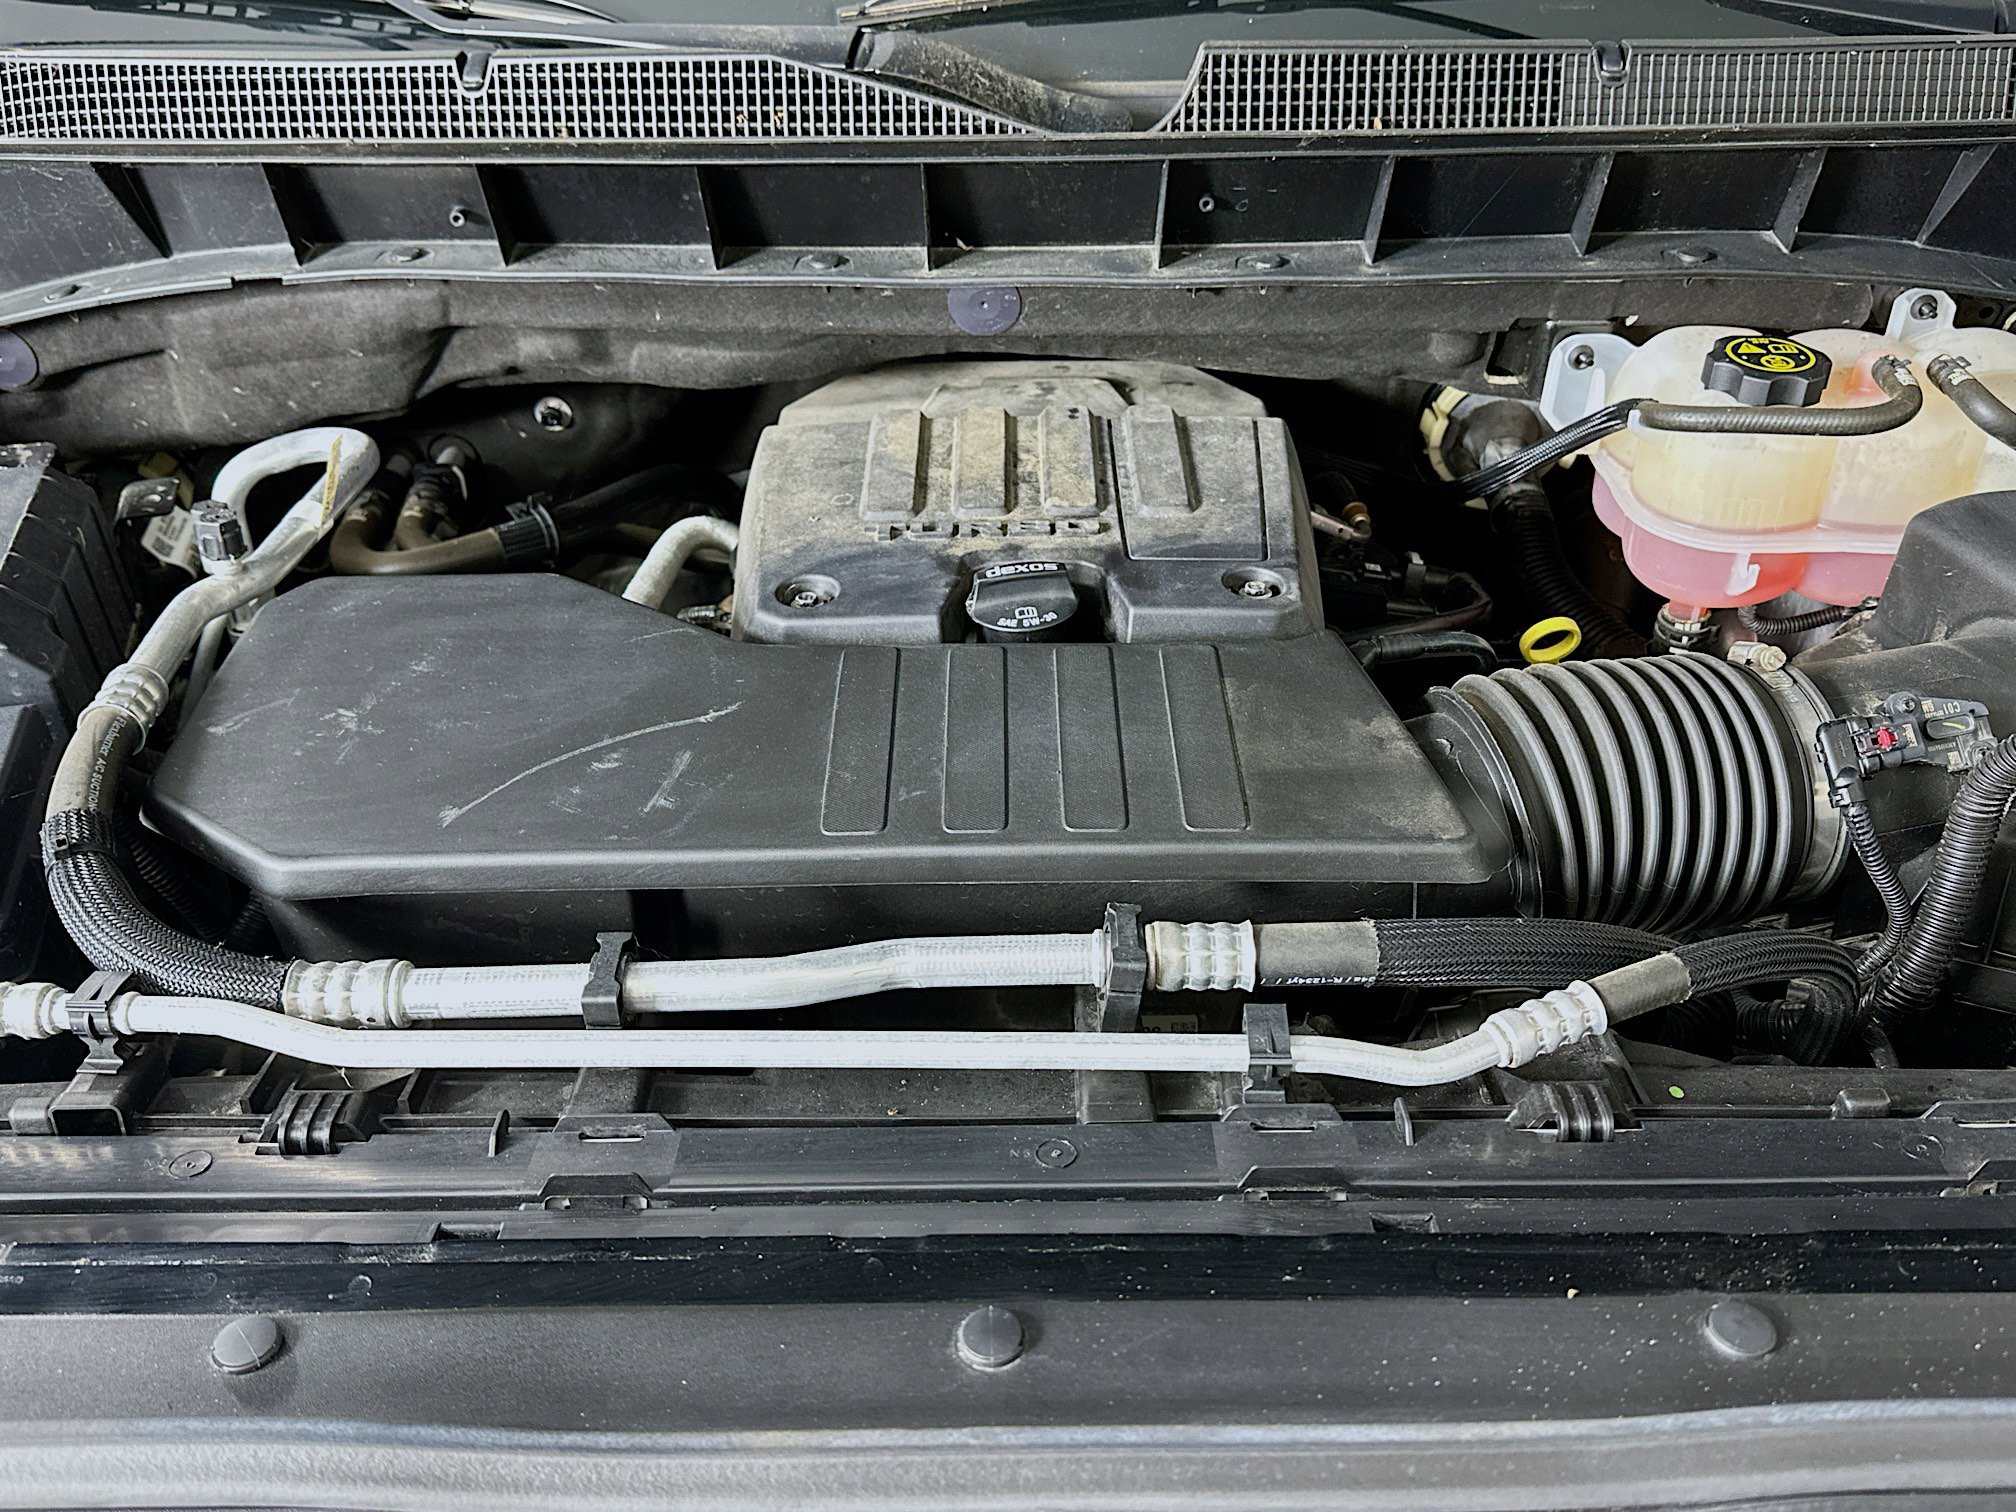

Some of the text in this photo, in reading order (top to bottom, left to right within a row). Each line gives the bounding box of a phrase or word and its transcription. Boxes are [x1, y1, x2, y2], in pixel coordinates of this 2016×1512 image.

[985, 563, 1059, 578] dexos
[997, 617, 1018, 628] SAE
[88, 772, 103, 813] SUCTION
